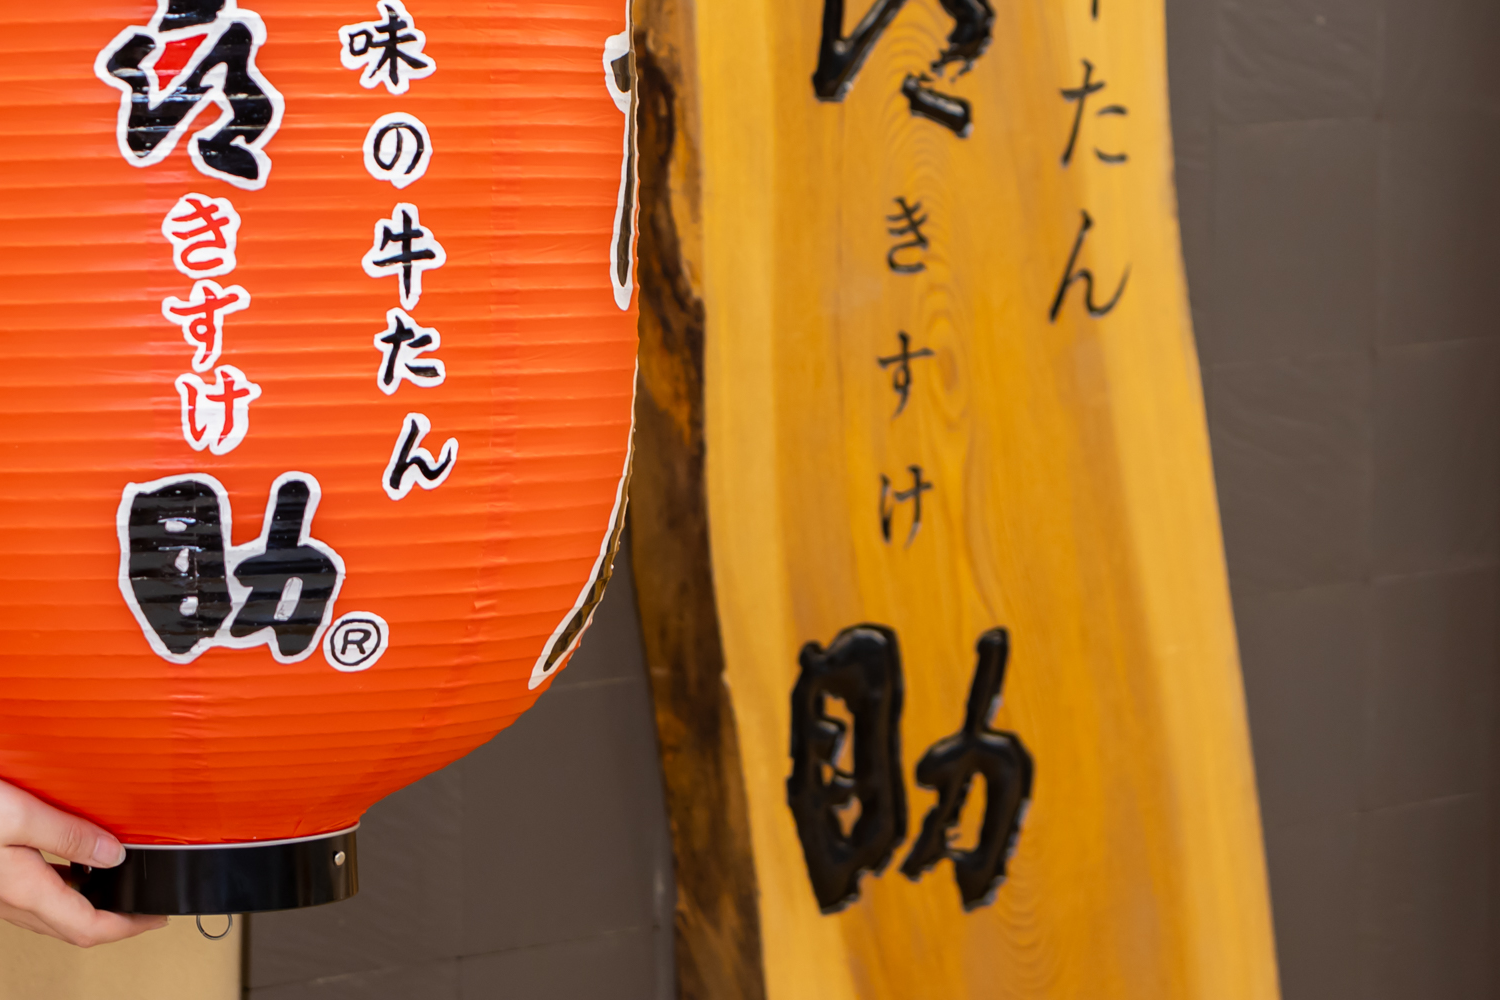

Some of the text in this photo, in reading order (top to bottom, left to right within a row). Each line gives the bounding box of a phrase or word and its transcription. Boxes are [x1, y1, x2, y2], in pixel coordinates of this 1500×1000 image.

[162, 193, 261, 455] きすけ
[340, 0, 457, 499] 味の牛たん
[877, 196, 934, 549] きすけ
[117, 472, 344, 663] 助
[786, 622, 1035, 915] 助
